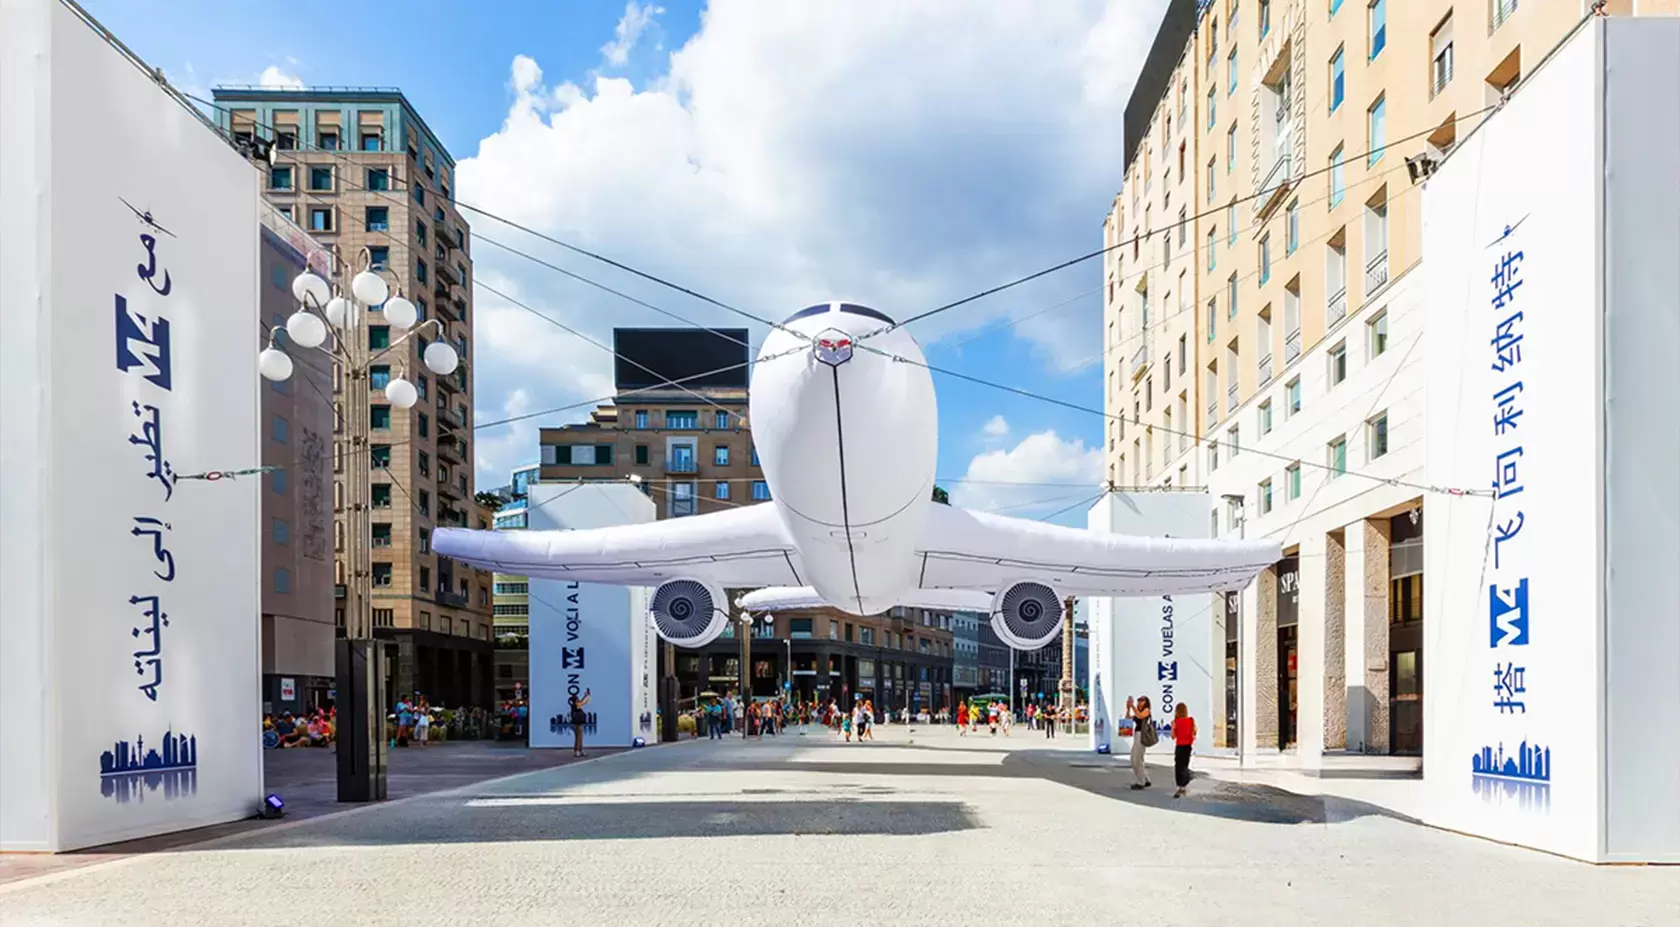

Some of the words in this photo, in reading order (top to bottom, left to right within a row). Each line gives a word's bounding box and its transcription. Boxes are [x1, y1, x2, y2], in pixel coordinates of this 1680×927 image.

[138, 234, 172, 296] مع
[115, 294, 171, 391] M4
[1491, 250, 1525, 570] 飞向利纳特
[129, 401, 173, 502] تطير
[131, 516, 175, 582] إلى
[566, 593, 579, 604] A
[566, 607, 579, 642] VOLI
[1490, 578, 1529, 648] M4
[129, 596, 170, 702] ليناته
[562, 647, 585, 669] M4
[1162, 605, 1174, 657] VUELAS
[1158, 661, 1178, 681] M4
[1162, 684, 1174, 714] CON
[1493, 662, 1526, 714] 搭
